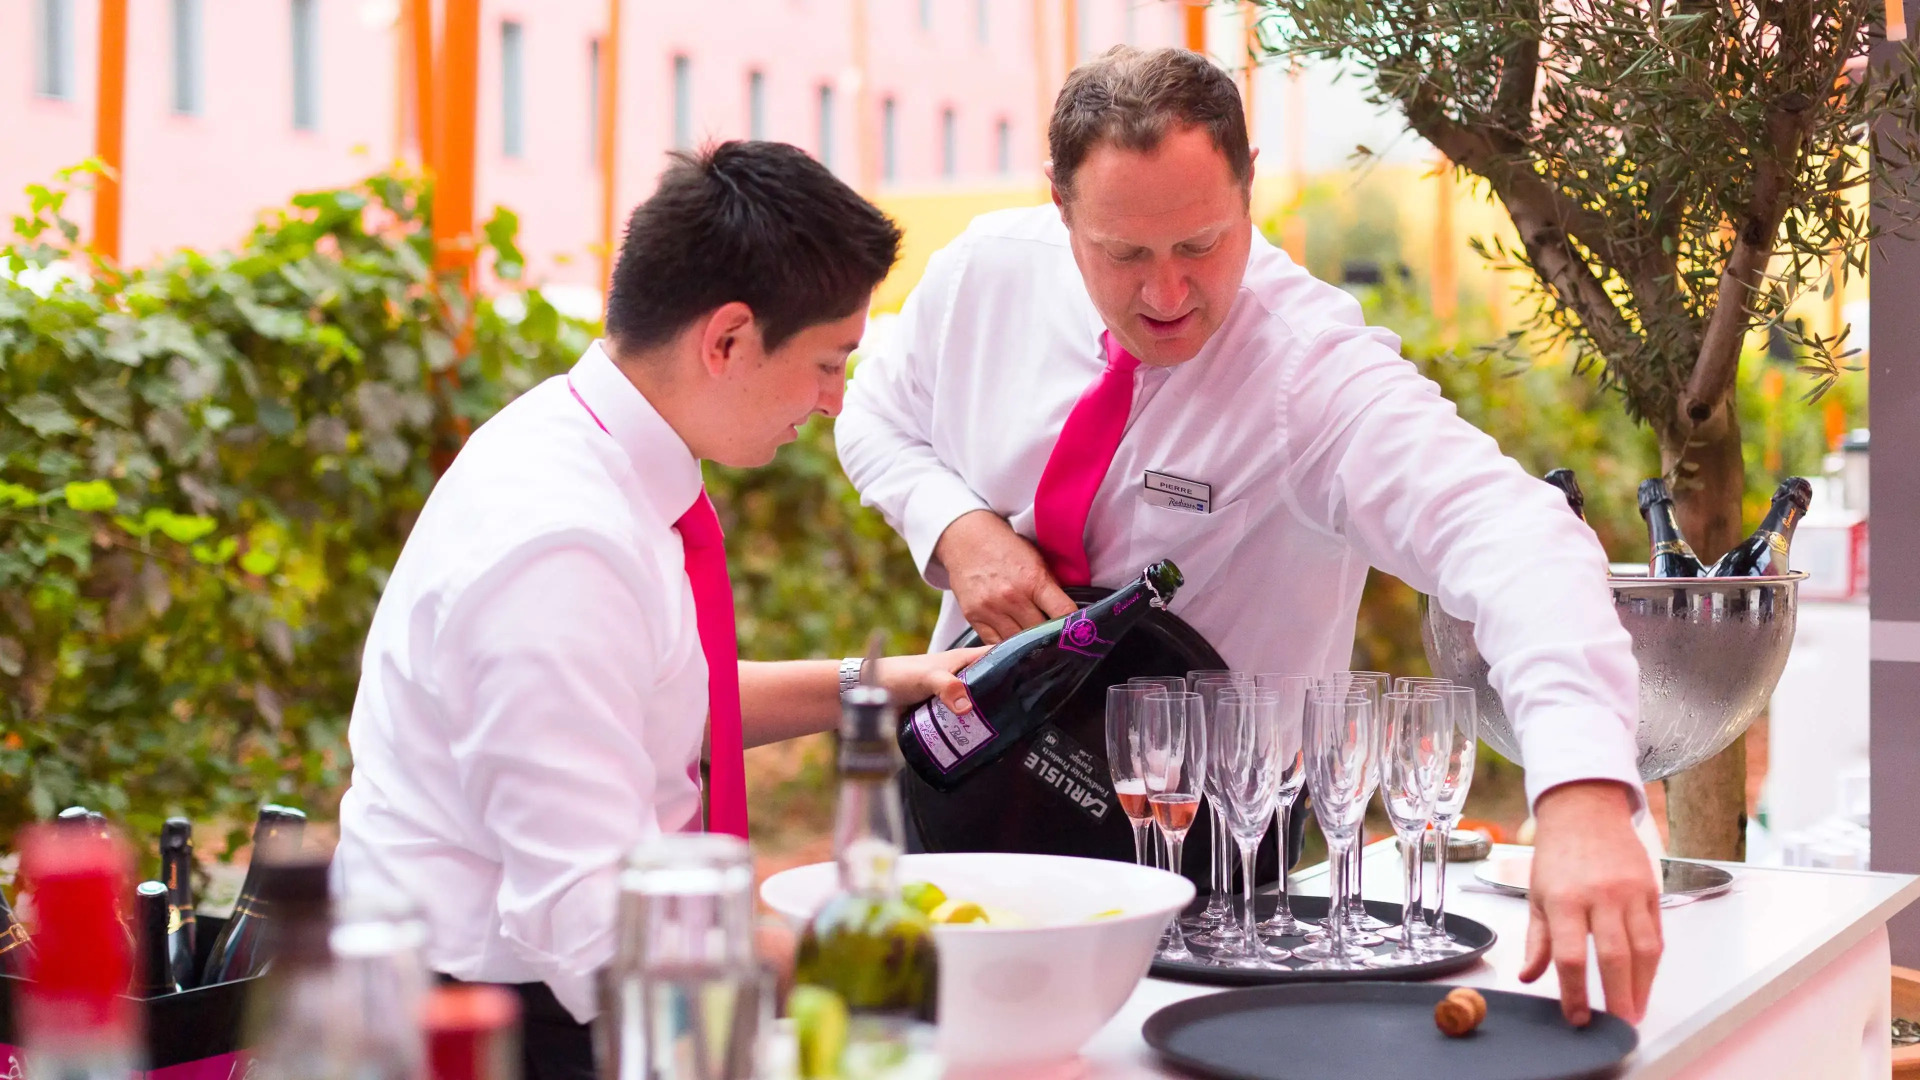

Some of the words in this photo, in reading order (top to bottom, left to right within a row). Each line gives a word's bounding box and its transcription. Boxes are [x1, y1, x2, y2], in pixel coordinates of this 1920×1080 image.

[1160, 482, 1192, 494] PIERRE
[1042, 746, 1070, 771] Products
[1069, 753, 1094, 774] Europe
[1024, 752, 1108, 818] CARLISLE
